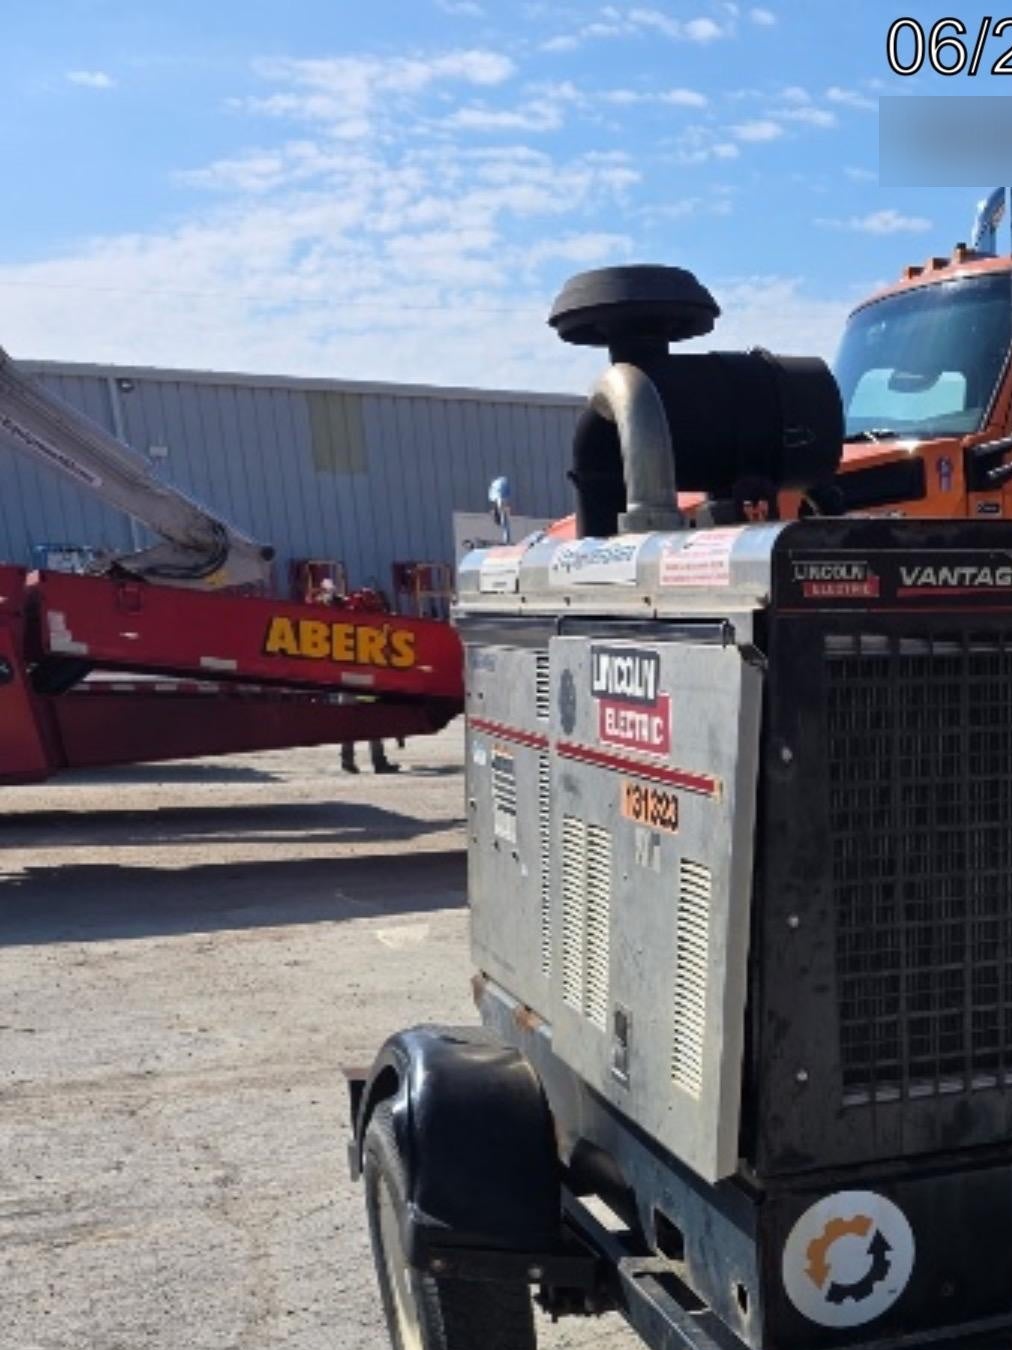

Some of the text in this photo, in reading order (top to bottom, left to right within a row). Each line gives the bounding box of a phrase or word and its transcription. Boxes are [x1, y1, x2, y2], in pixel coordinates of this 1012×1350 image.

[794, 563, 864, 581] LINCOLN
[264, 615, 416, 668] ABER'S
[592, 652, 657, 700] LINCOLN
[604, 706, 665, 745] ELECTRIC
